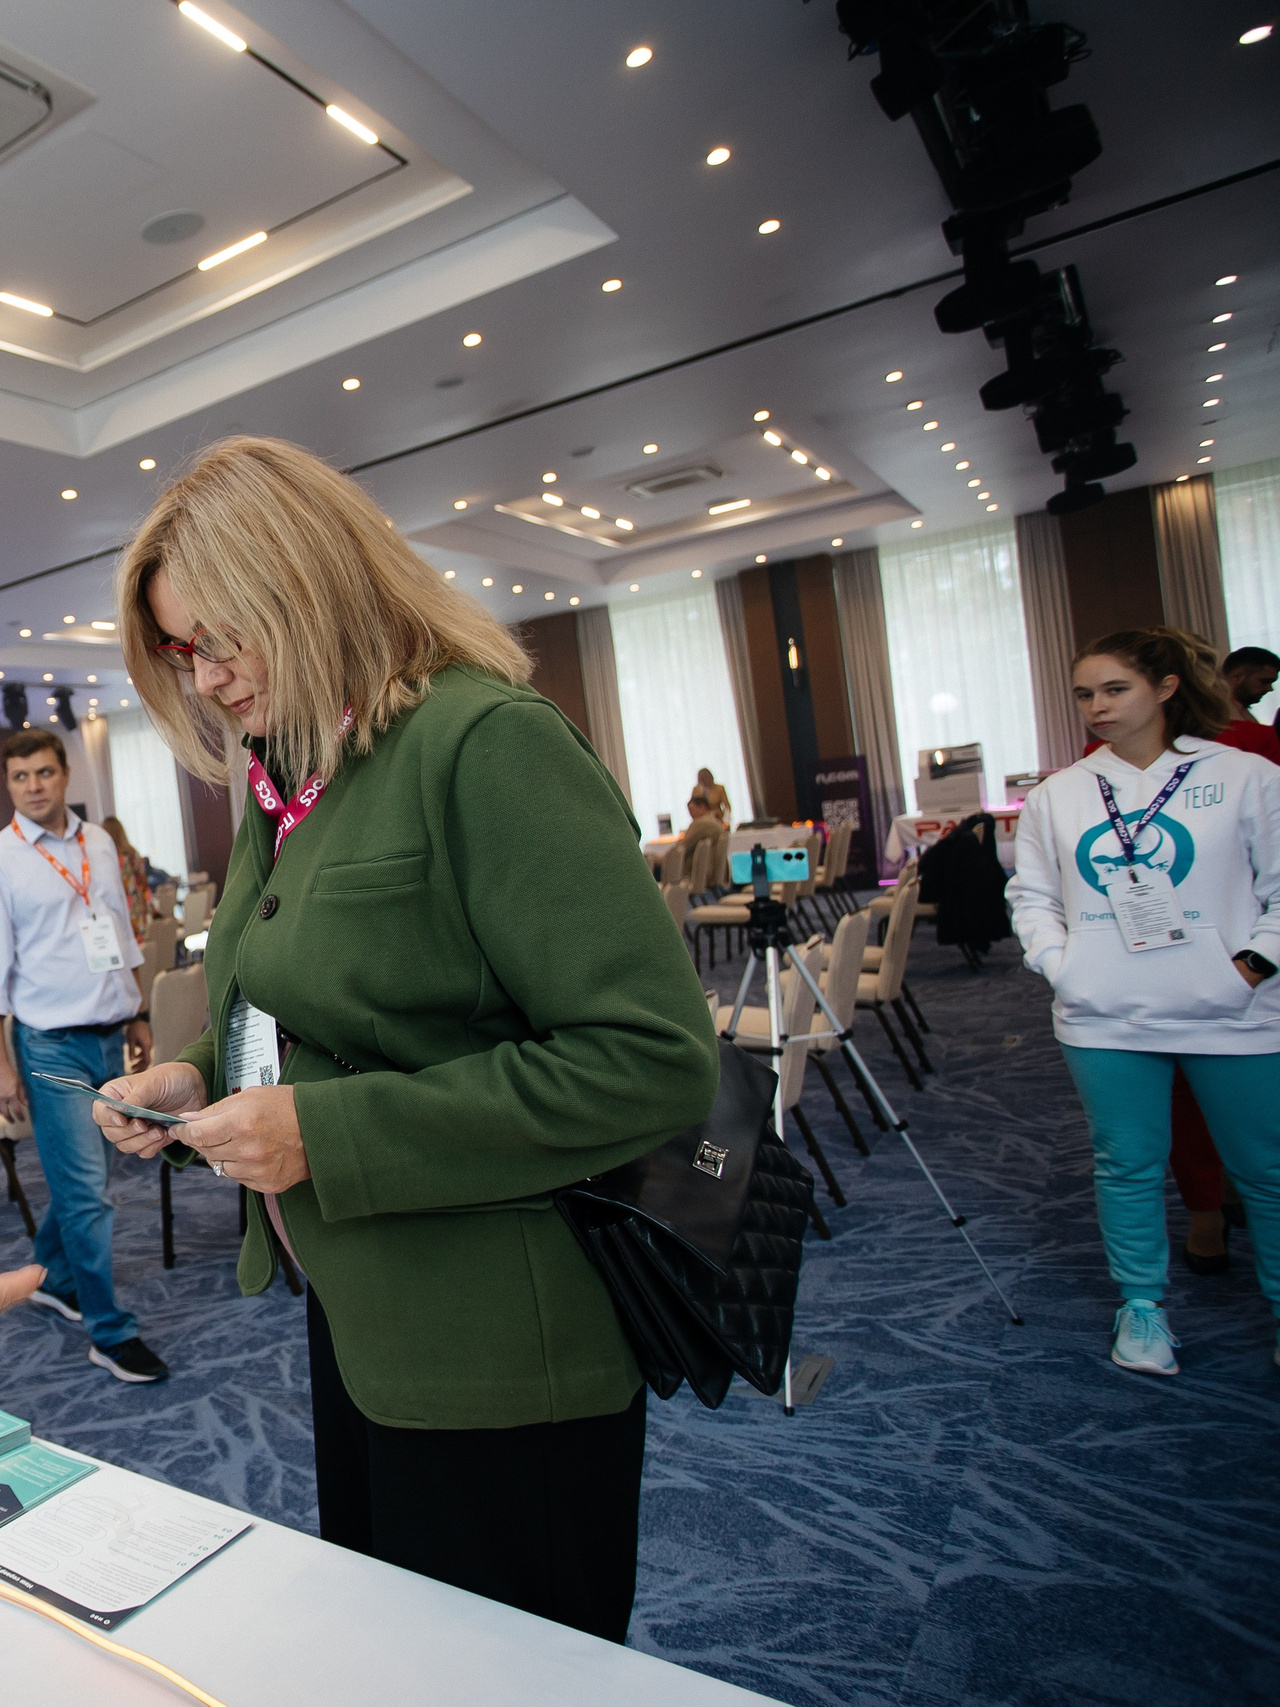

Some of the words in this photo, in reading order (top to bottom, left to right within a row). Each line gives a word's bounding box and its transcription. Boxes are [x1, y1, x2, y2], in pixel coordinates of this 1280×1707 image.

[255, 780, 277, 811] OCS
[299, 778, 325, 808] OCS
[1182, 782, 1224, 810] TEGU
